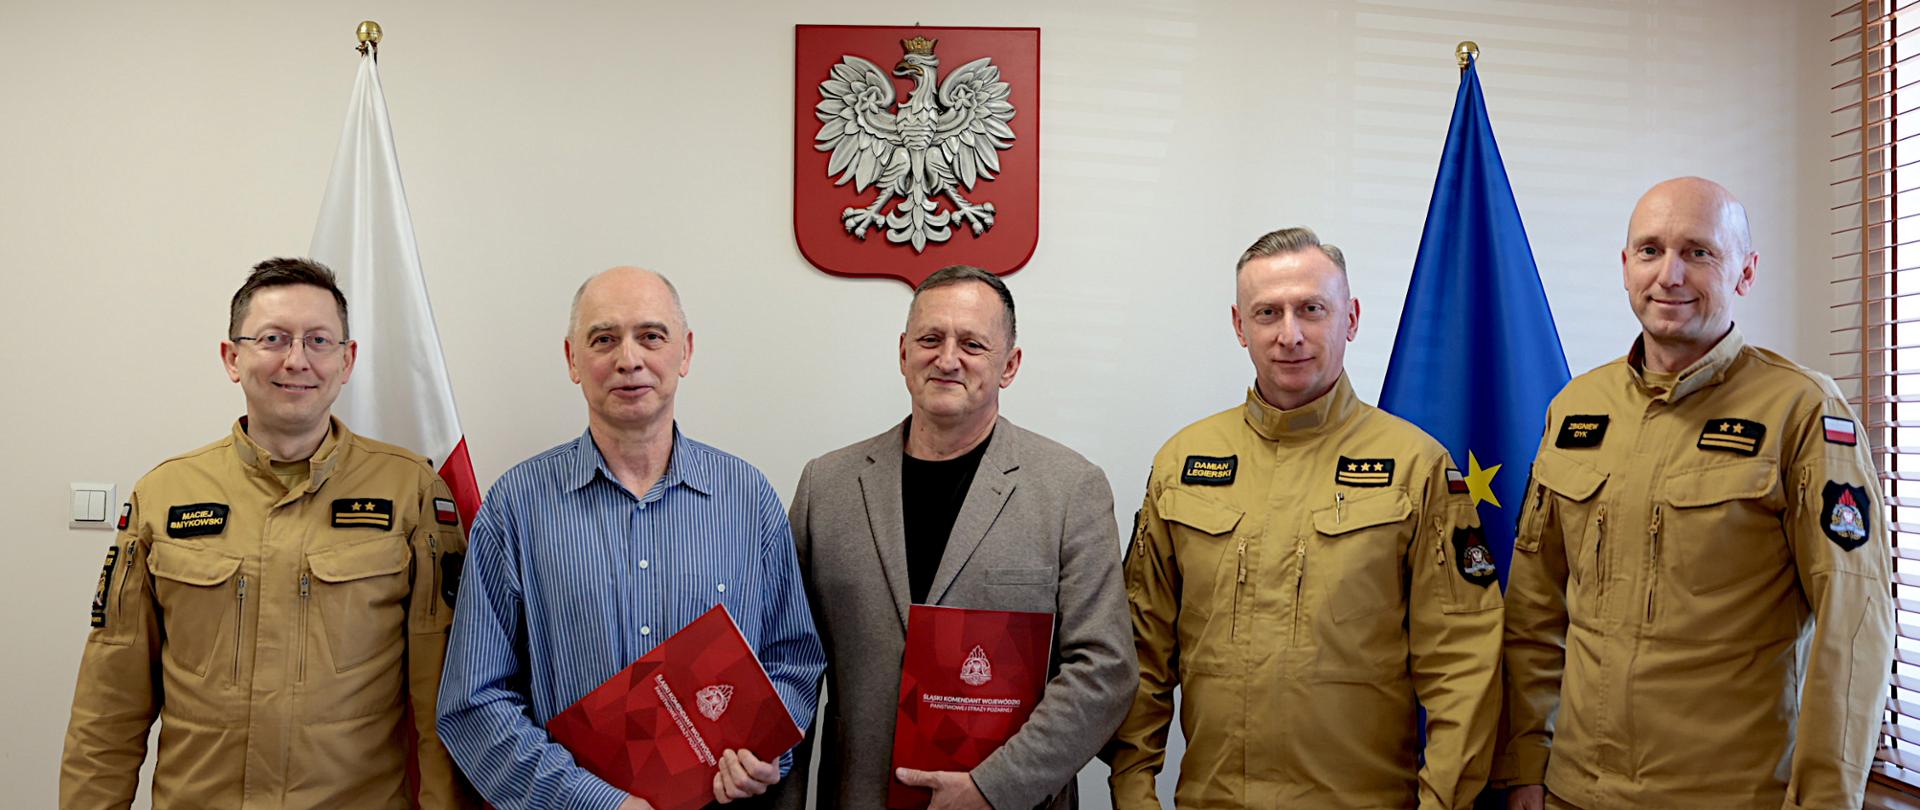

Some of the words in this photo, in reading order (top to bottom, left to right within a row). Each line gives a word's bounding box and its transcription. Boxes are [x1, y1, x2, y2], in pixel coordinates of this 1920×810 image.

[1573, 430, 1588, 438] DYK
[1193, 461, 1229, 470] DAMIAN
[1187, 469, 1232, 478] LEGIERSKI
[182, 510, 214, 520] MACIEJ
[944, 696, 981, 704] KOMENDANT
